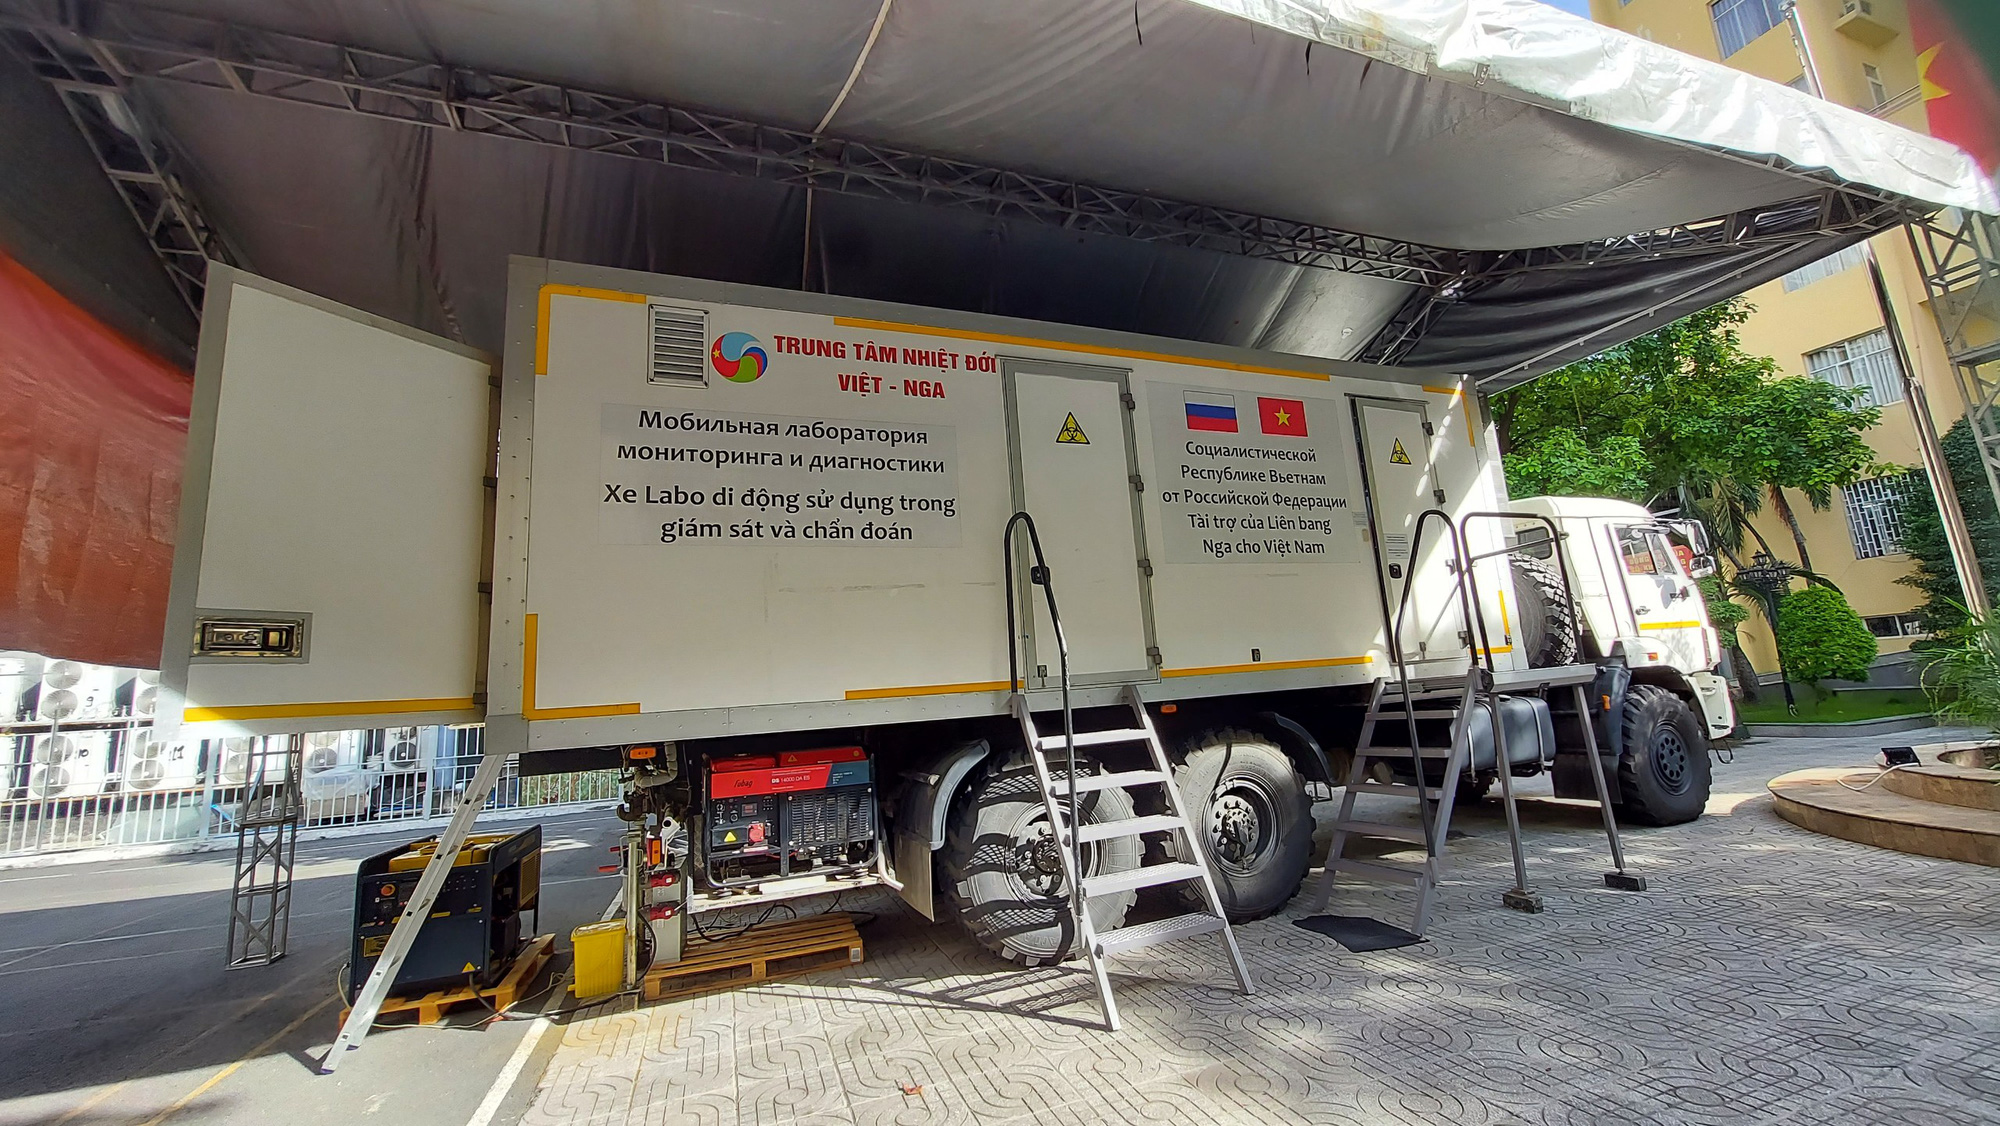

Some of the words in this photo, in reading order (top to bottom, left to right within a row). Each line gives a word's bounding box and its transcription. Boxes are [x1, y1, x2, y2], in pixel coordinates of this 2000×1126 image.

[774, 335, 847, 359] TRUNG
[852, 340, 898, 364] TÂM
[902, 347, 960, 373] NHIỆT
[964, 351, 997, 374] ĐỚI
[837, 371, 883, 397] VIỆT
[902, 379, 946, 398] NGA
[638, 410, 779, 436] Мобильная
[784, 421, 928, 447] лаборатория
[617, 444, 783, 469] мониторинга
[790, 453, 803, 467] и
[808, 454, 945, 473] диагностики
[1185, 440, 1317, 463] Социалистической
[1180, 464, 1267, 484] Республике
[1269, 469, 1326, 485] Вьетнам
[603, 483, 637, 504] Xe
[645, 484, 705, 506] Labo
[711, 486, 734, 506] di
[740, 487, 800, 514] động
[805, 488, 835, 509] sử
[839, 491, 894, 516] dụng
[899, 495, 956, 517] trong
[1162, 490, 1180, 503] от
[1184, 488, 1269, 506] Российской
[1272, 491, 1347, 511] Федерации
[660, 517, 722, 543] giám
[728, 518, 765, 538] sát
[769, 520, 796, 539] và
[802, 517, 855, 539] chẩn
[860, 521, 913, 540] đoán
[1188, 513, 1210, 529] Tài
[1213, 515, 1237, 533] trợ
[1240, 513, 1264, 530] của
[1268, 515, 1296, 530] Liên
[1299, 515, 1332, 535] bang
[1203, 539, 1232, 558] Nga
[1236, 538, 1261, 554] cho
[1264, 538, 1292, 557] Việt
[1295, 540, 1325, 554] Nam
